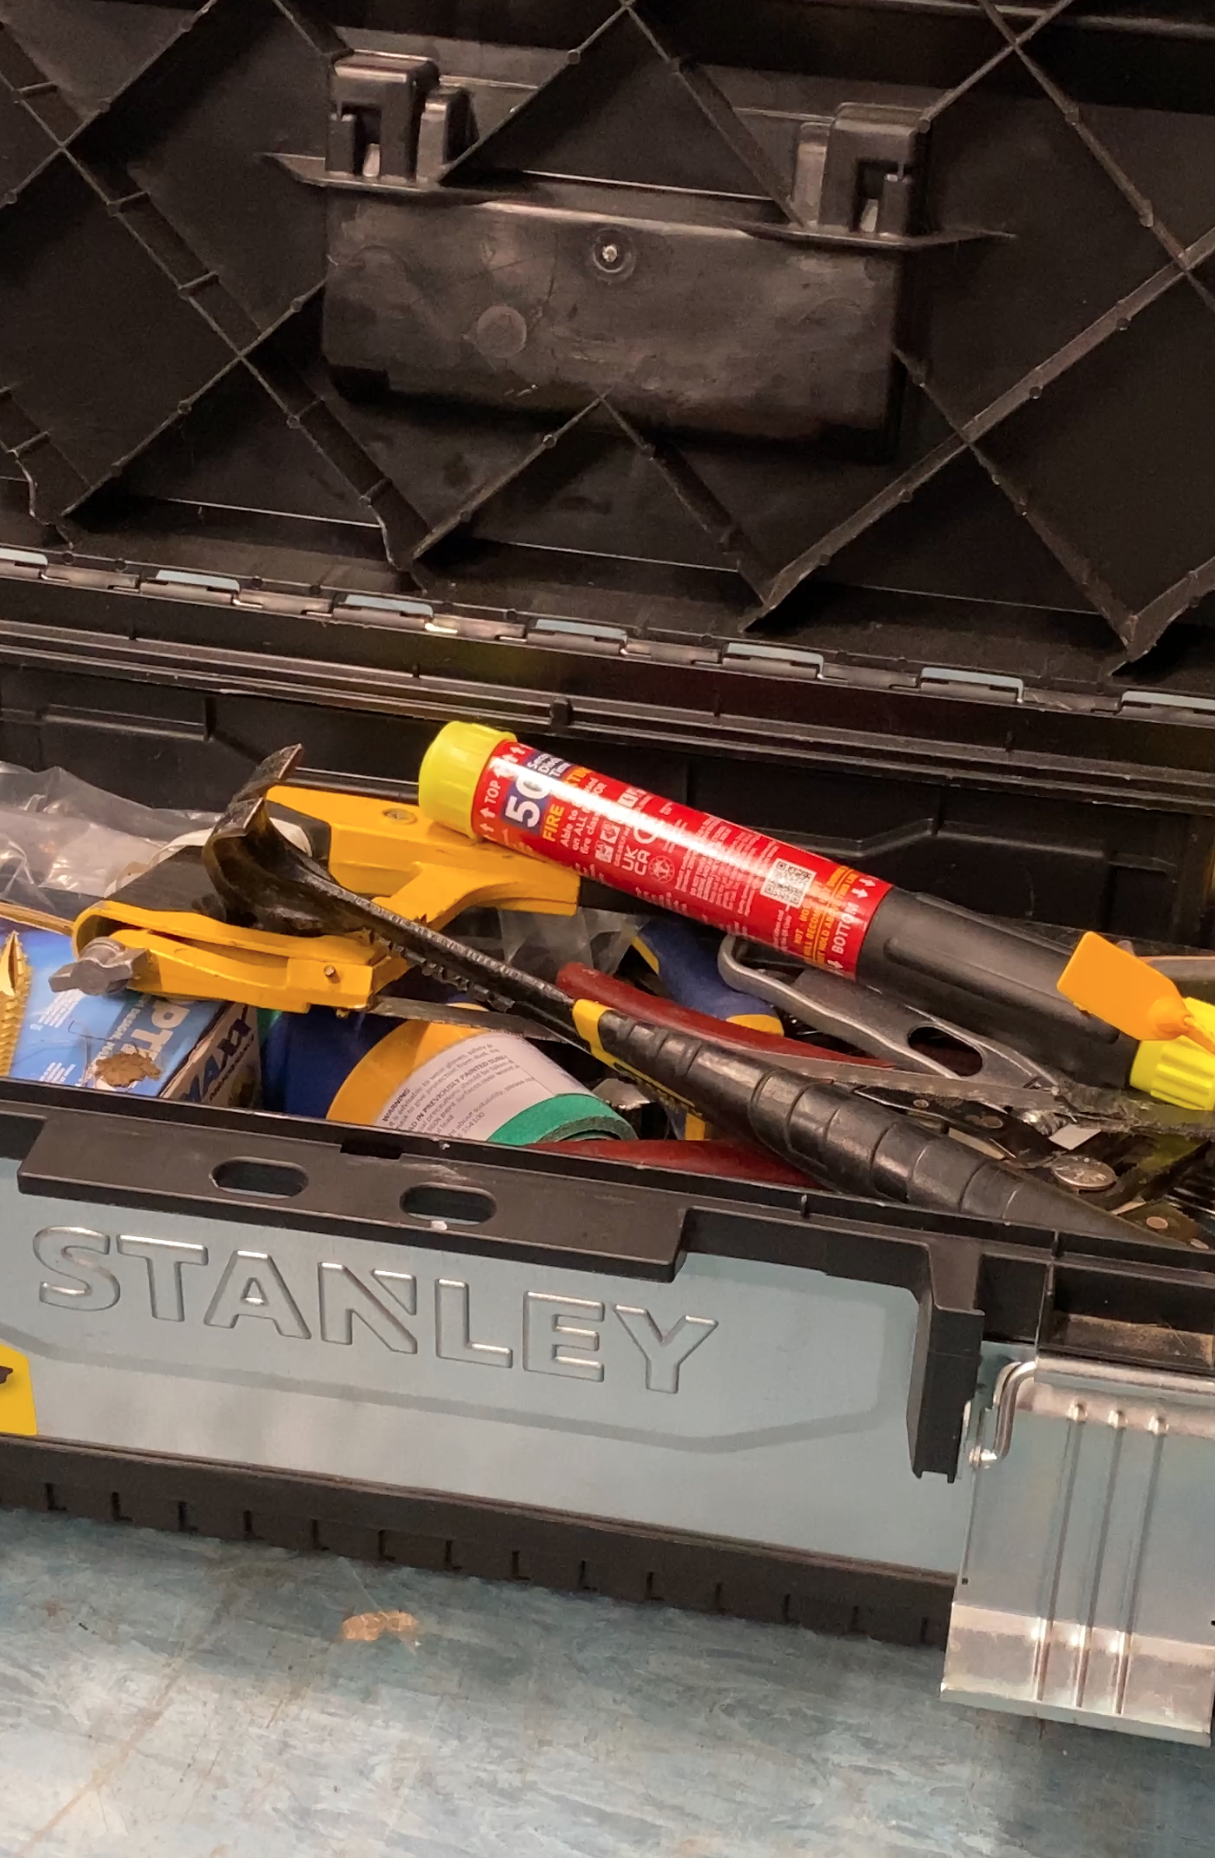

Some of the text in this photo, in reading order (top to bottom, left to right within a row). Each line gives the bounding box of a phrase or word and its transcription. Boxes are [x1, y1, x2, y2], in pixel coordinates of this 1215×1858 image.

[484, 780, 501, 805] TOP
[505, 774, 551, 828] 50
[542, 803, 565, 842] FIRE
[560, 824, 574, 847] Able
[568, 810, 578, 821] to
[572, 816, 588, 850] on ALL
[580, 837, 592, 855] fire
[622, 848, 638, 871] UK
[634, 850, 650, 876] CA
[832, 902, 859, 954] BOTTOM
[382, 1087, 410, 1121] WARNING
[397, 1085, 422, 1115] advisable
[414, 1093, 426, 1107] give
[425, 1066, 458, 1095] protection
[415, 1112, 424, 1121] IN
[422, 1077, 460, 1113] PREVIOUSLY
[459, 1061, 489, 1080] PAINTED
[440, 1101, 456, 1118] paint
[455, 1081, 483, 1103] surfaces
[426, 1087, 461, 1122] precautions
[439, 1113, 454, 1128] lead
[32, 1226, 718, 1394] STANLEY
